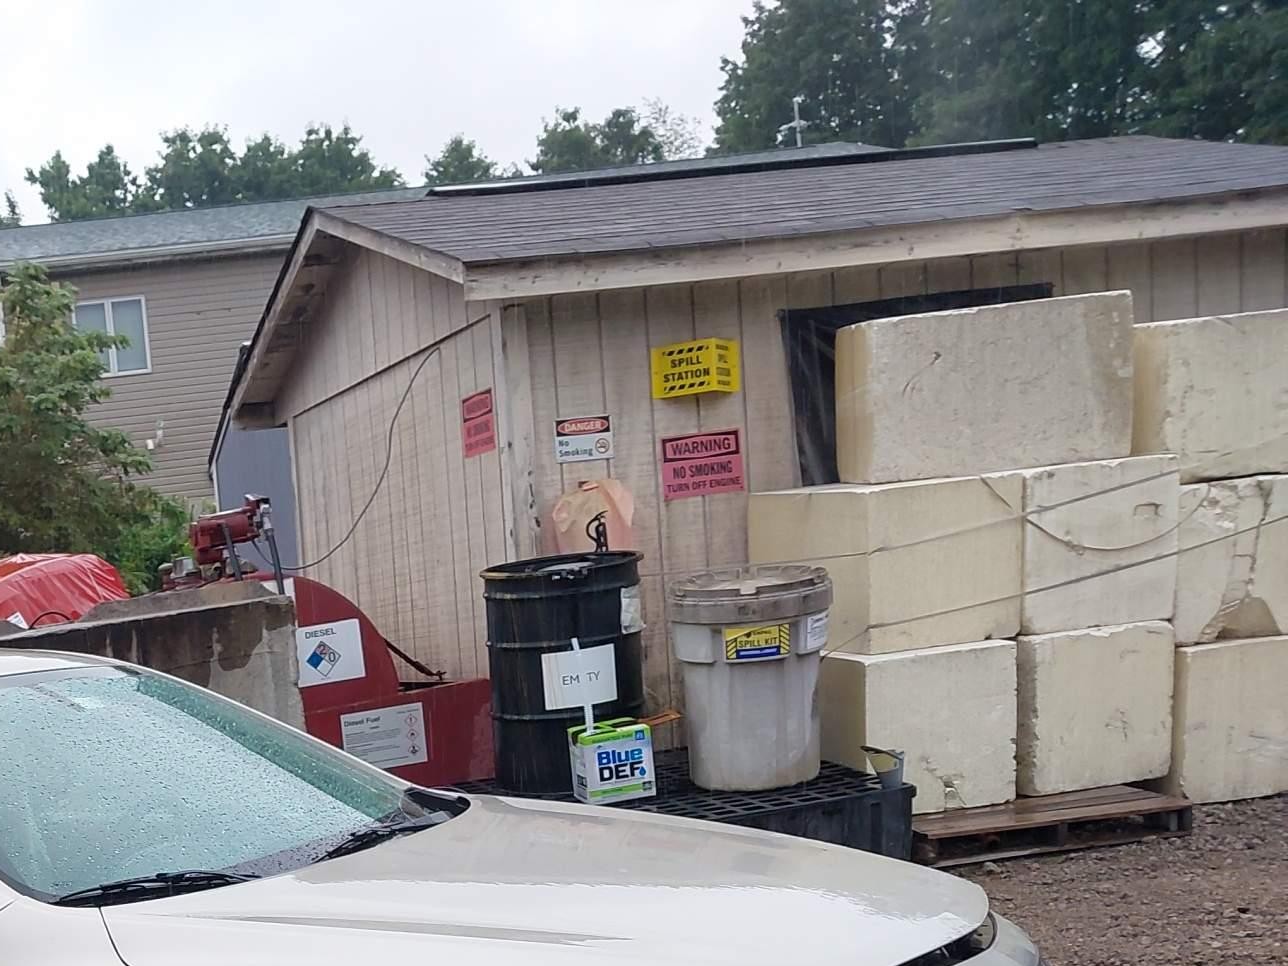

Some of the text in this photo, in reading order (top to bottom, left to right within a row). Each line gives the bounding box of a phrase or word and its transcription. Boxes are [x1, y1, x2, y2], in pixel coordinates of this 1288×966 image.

[670, 355, 702, 368] SPILL
[663, 367, 710, 383] STATION
[564, 419, 603, 432] DANGER
[559, 447, 593, 457] Smoking
[670, 437, 731, 456] WARNING
[673, 460, 732, 479] NO SMOKING
[666, 476, 742, 493] TURN OFF ENGINE
[305, 627, 336, 639] DIESEL
[317, 644, 328, 655] 2
[738, 637, 778, 649] SPILL KIT
[597, 748, 643, 766] Blue
[599, 760, 644, 782] DEF
